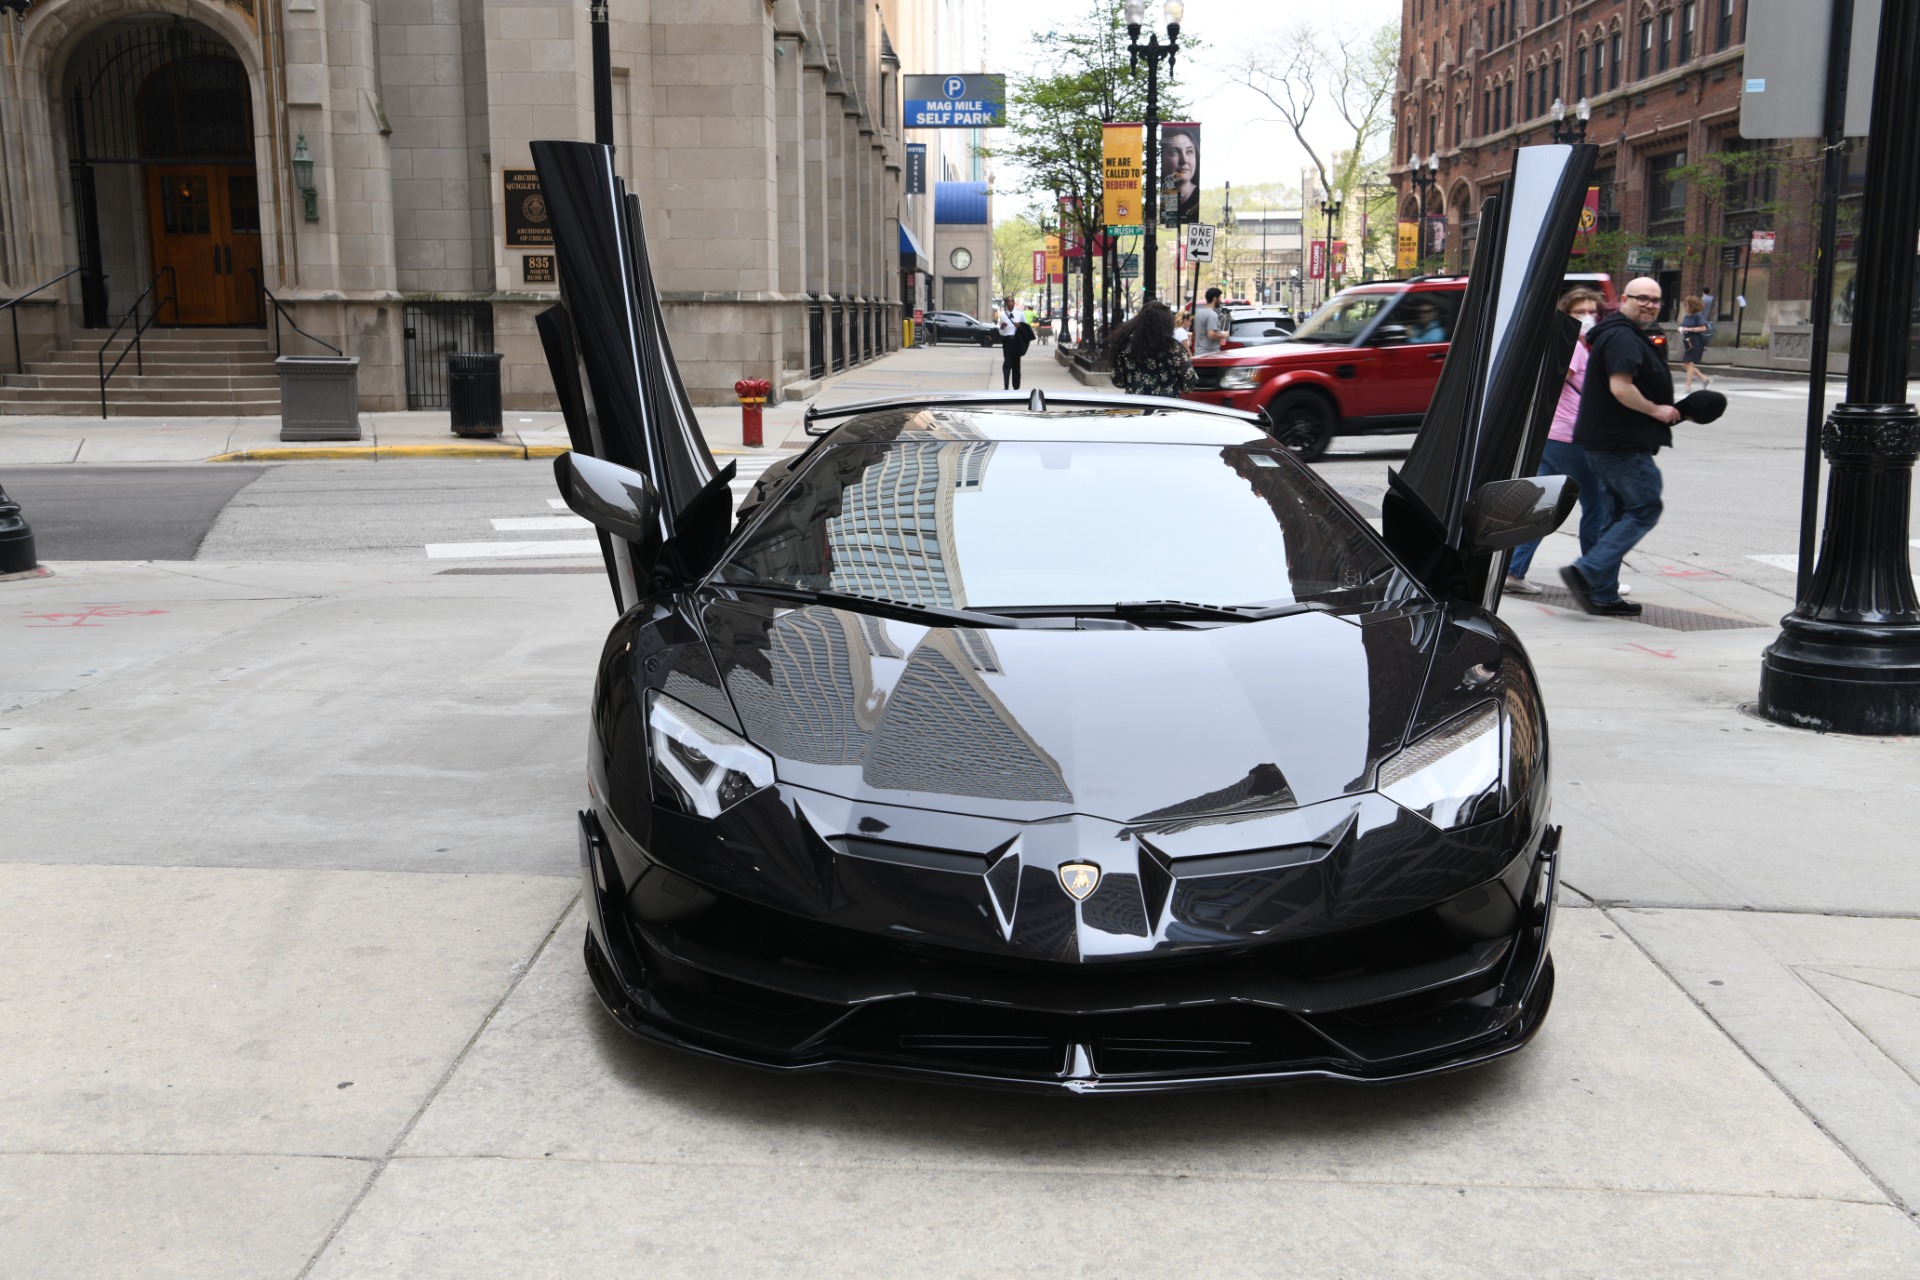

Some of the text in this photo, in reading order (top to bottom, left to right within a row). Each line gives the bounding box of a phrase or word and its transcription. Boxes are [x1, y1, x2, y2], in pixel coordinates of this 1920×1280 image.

[948, 80, 961, 96] P
[926, 101, 982, 111] MAG MILE
[916, 112, 992, 125] SELF PARK
[1105, 157, 1131, 167] WE ARE
[1105, 168, 1140, 179] CALLED TO
[505, 182, 536, 190] QUIGLEY
[1105, 180, 1138, 190] REDEFINE
[1114, 227, 1134, 235] RUSH
[1191, 227, 1212, 238] ONE
[1190, 237, 1212, 248] WAY
[528, 256, 549, 269] 835
